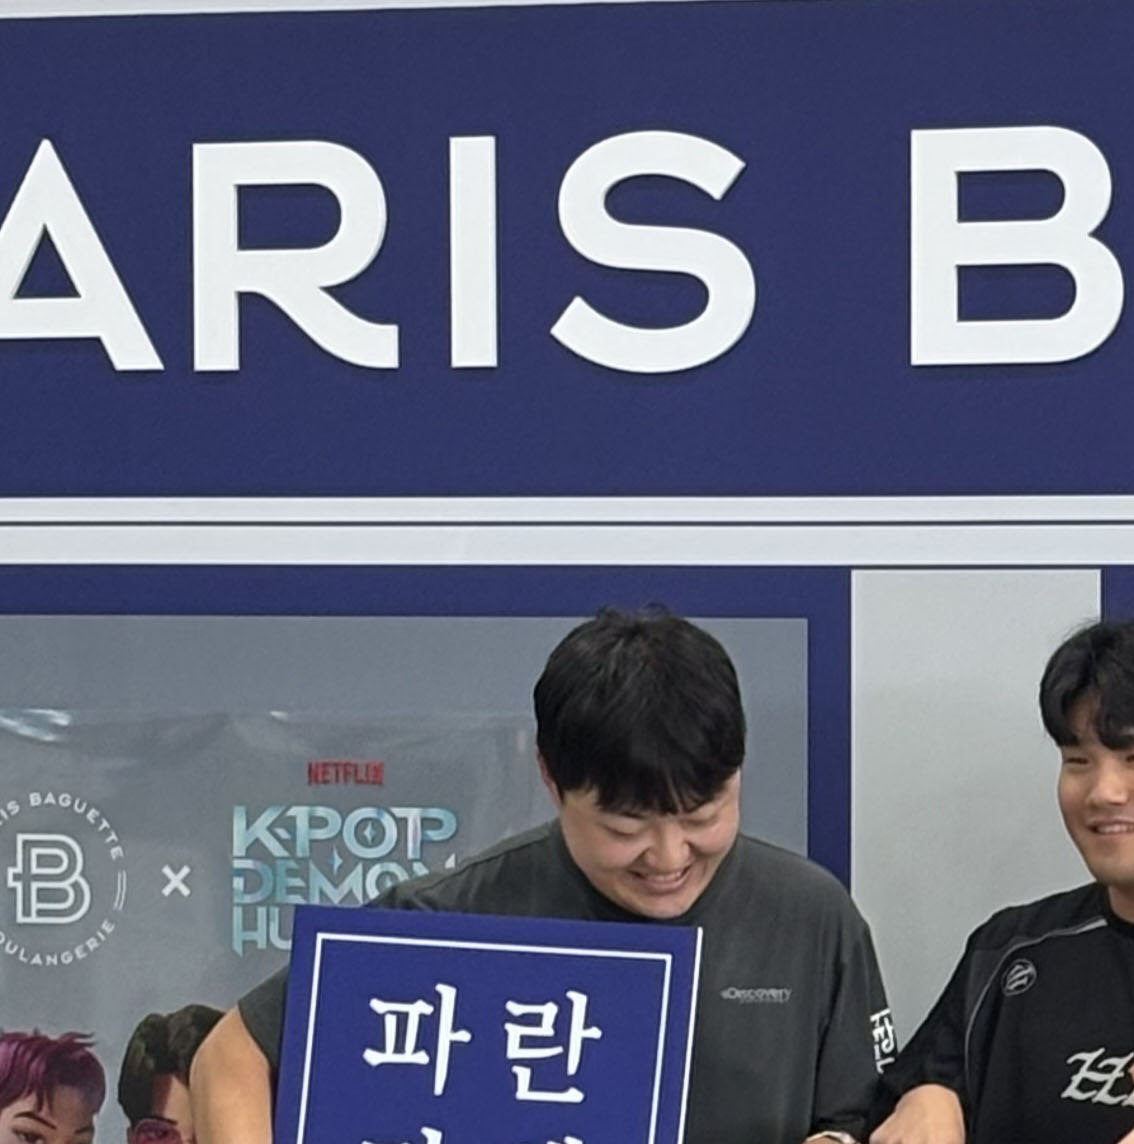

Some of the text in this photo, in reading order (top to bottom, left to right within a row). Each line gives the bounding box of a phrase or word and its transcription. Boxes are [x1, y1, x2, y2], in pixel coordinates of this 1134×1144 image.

[0, 130, 757, 374] ARIS
[307, 761, 384, 786] NETFLIX
[29, 792, 125, 861] BAGUETTE
[232, 858, 456, 906] DEMO
